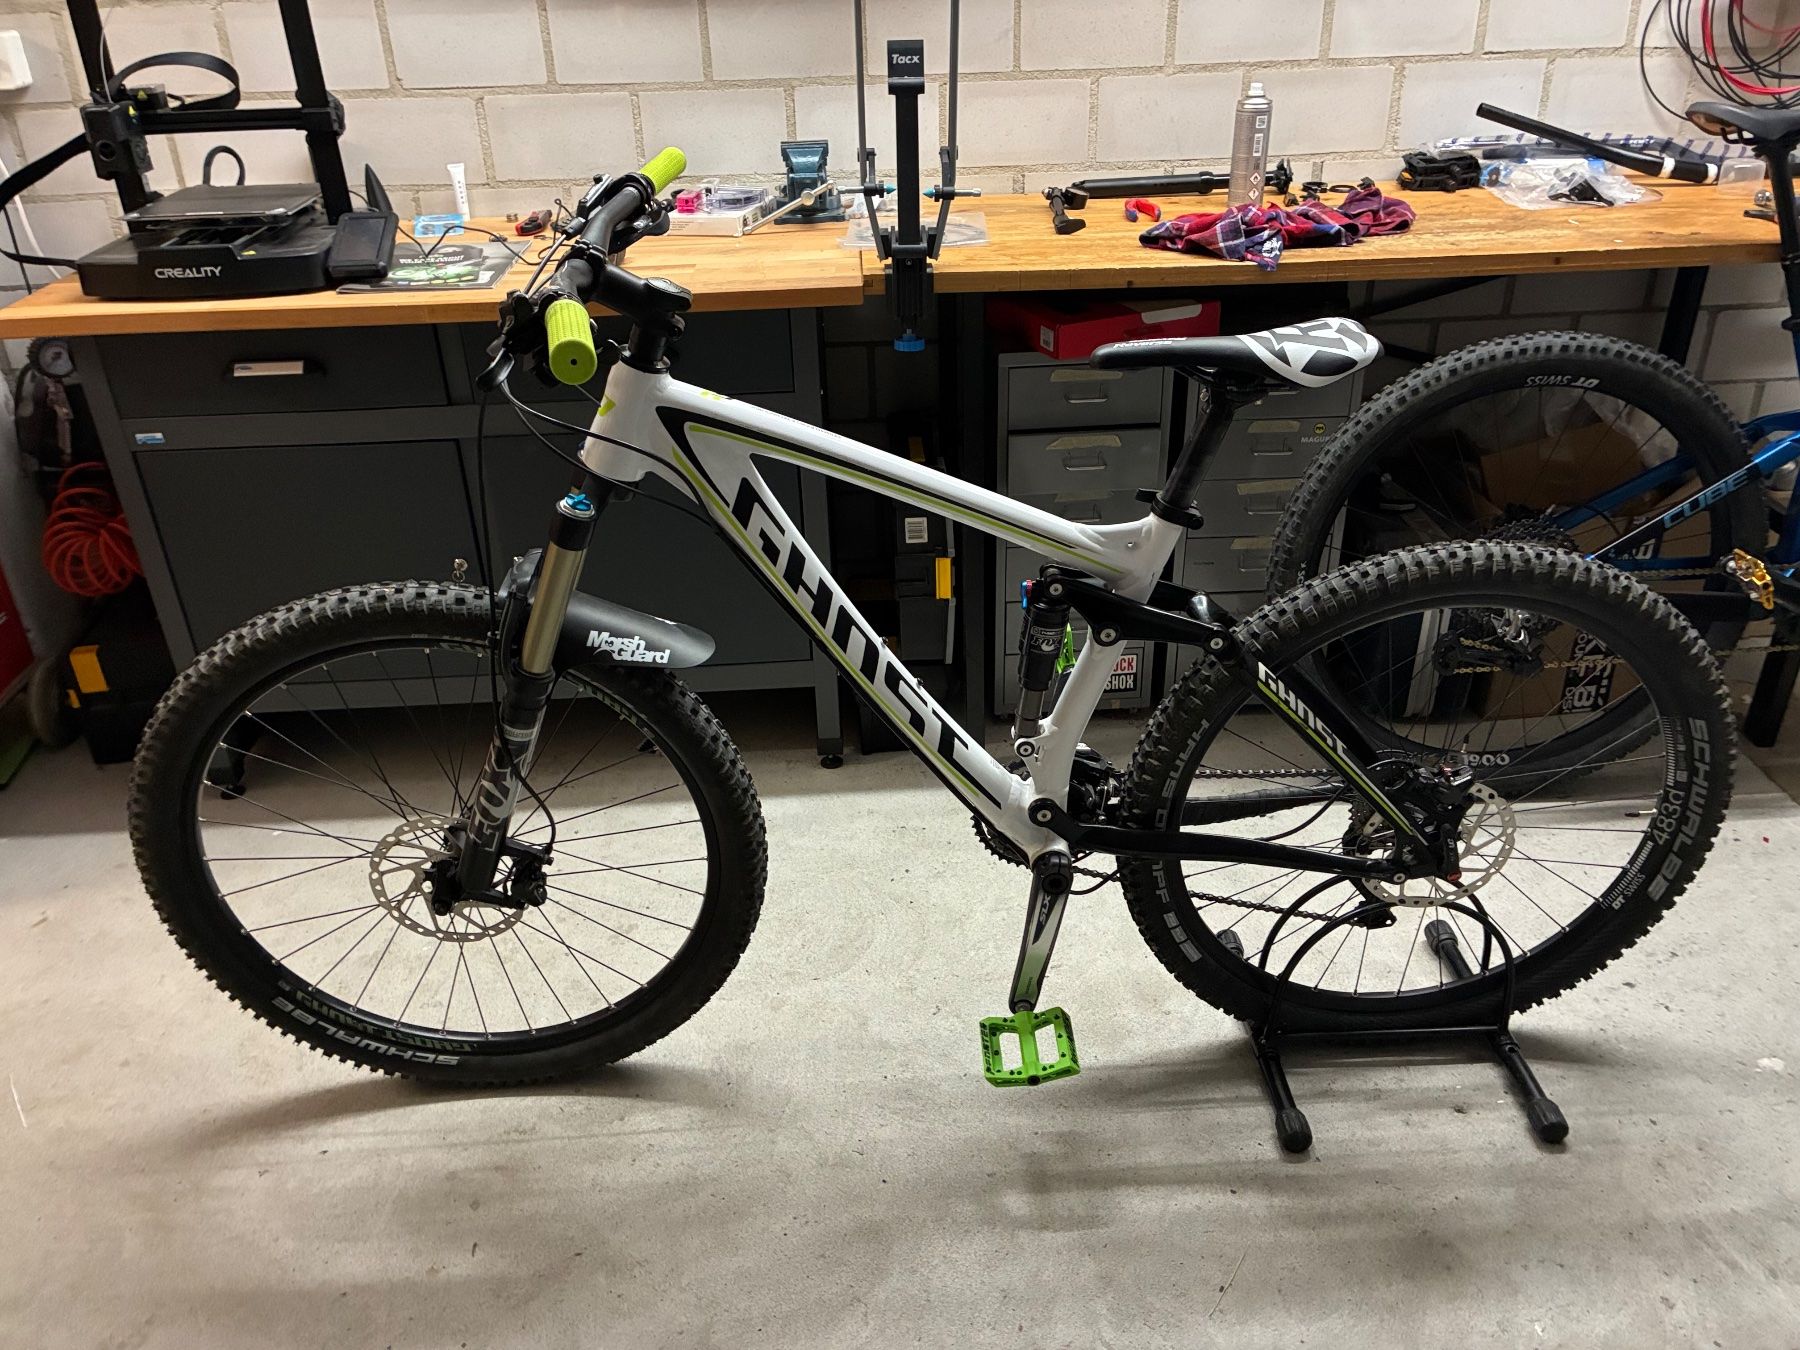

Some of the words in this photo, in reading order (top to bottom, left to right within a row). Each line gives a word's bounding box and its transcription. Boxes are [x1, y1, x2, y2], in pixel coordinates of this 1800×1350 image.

[891, 53, 920, 65] Tacx
[154, 266, 222, 279] CREALITY
[1524, 375, 1572, 387] SWISS
[1663, 469, 1750, 529] CUBE
[586, 630, 646, 649] Marsh
[732, 476, 1001, 809] GHOST
[612, 647, 671, 664] Guard
[1647, 717, 1711, 901] SCHWALBE
[271, 996, 460, 1066] SCHWALBE
